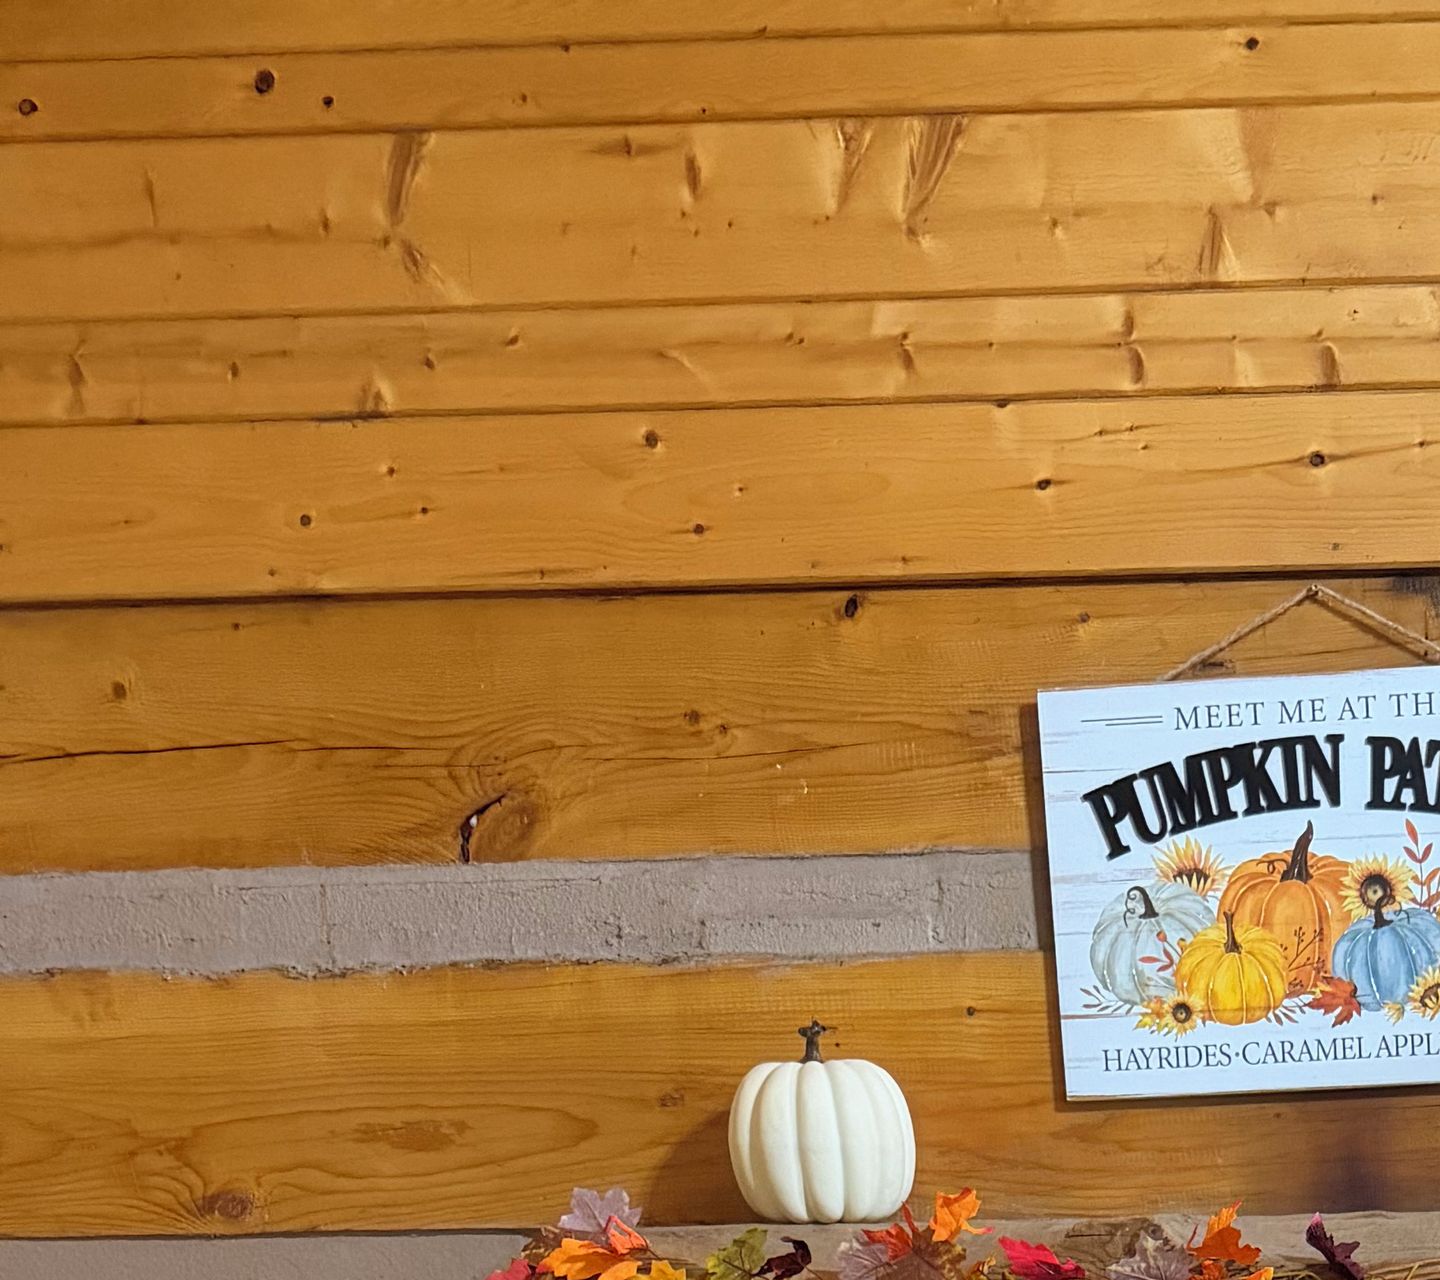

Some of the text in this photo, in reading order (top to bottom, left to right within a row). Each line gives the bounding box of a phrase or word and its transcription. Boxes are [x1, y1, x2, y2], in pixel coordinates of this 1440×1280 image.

[1173, 701, 1264, 731] MEET
[1278, 697, 1327, 725] ME
[1337, 694, 1376, 722] AT
[1081, 734, 1346, 861] PUMPKIN
